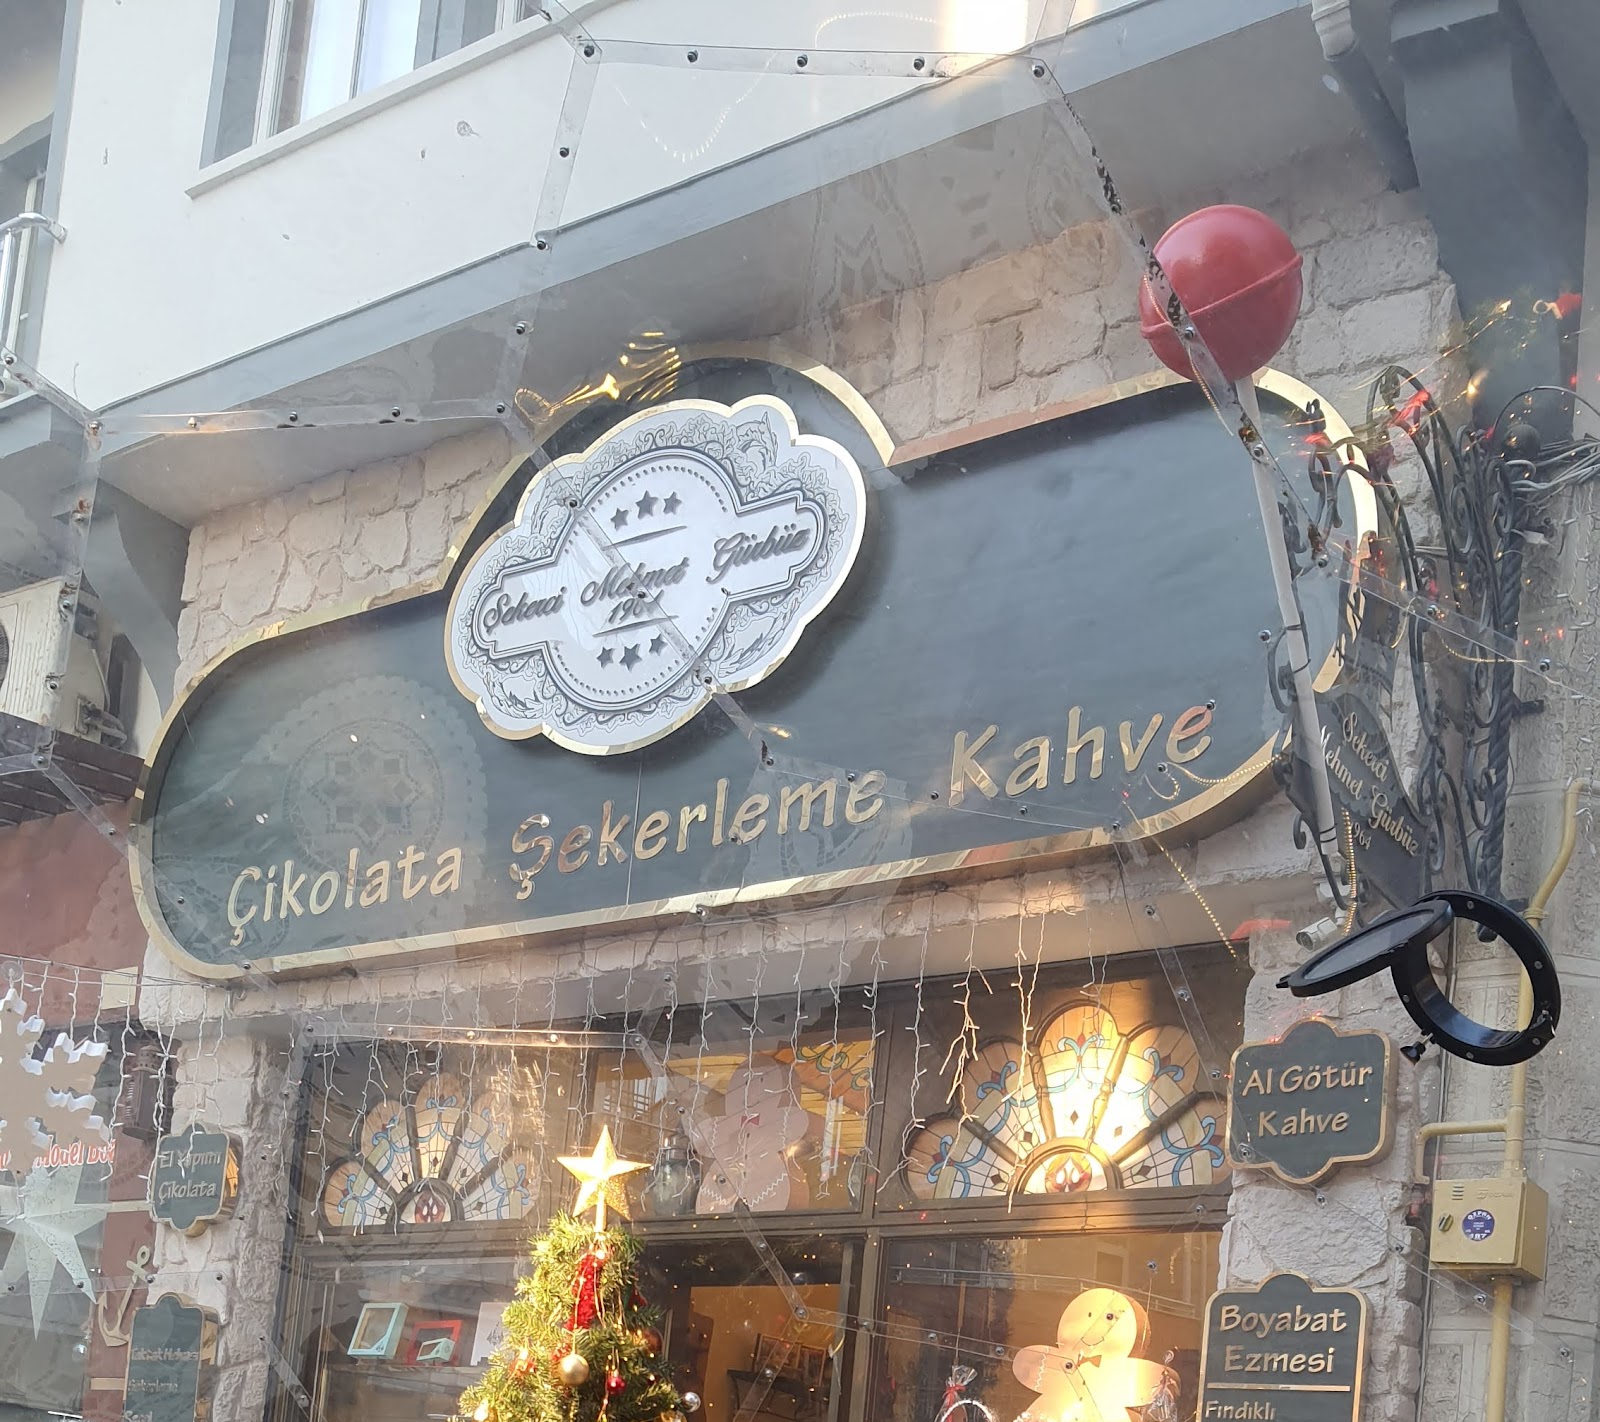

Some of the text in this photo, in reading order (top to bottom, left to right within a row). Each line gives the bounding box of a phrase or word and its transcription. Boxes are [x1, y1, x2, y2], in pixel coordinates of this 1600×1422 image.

[705, 522, 811, 584] Gürbüz
[227, 704, 1214, 946] Çikolata Şekerleme Kahve
[1368, 784, 1420, 857] Gürbüz
[1242, 1063, 1373, 1097] Al Götür
[1257, 1108, 1348, 1138] Kahve
[159, 1151, 173, 1169] El
[158, 1182, 216, 1206] Çikolata
[1219, 1304, 1347, 1339] Boyabat
[1224, 1346, 1335, 1375] Ezmesi
[1204, 1400, 1276, 1421] Fındıklı
